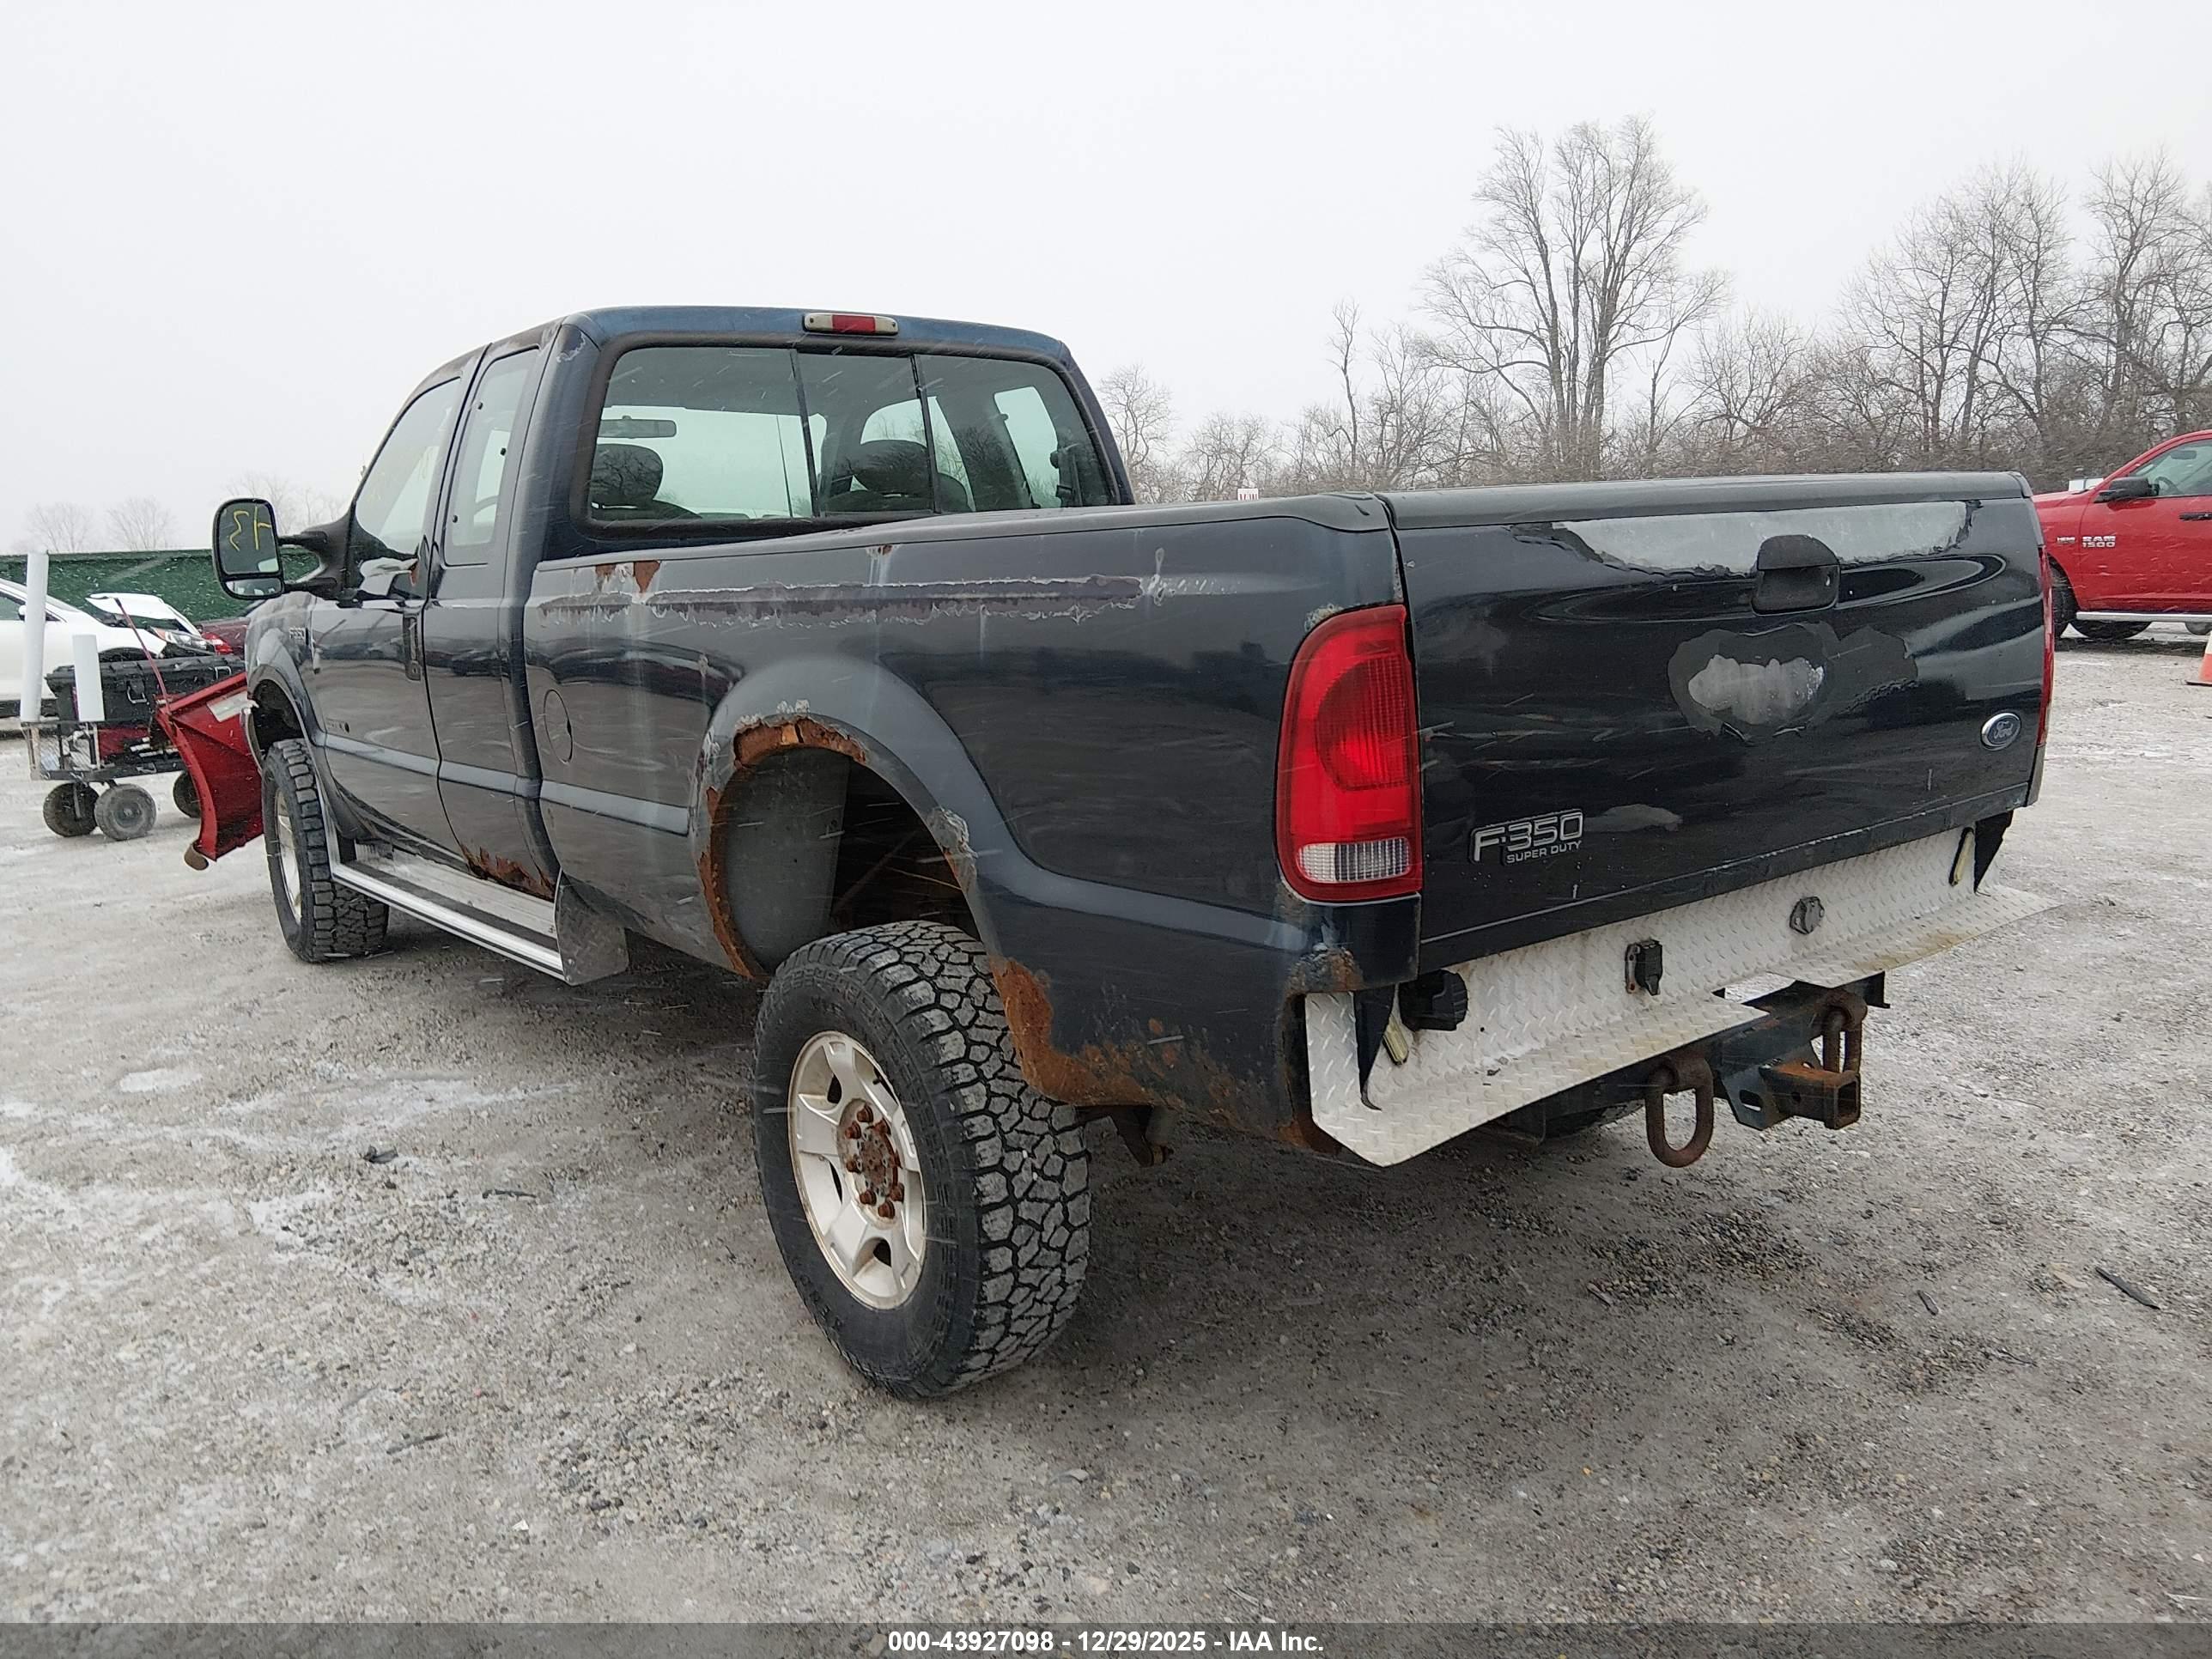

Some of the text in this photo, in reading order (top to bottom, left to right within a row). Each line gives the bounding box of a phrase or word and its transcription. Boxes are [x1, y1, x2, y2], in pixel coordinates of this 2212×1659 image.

[1993, 720, 2014, 739] Ford
[1506, 840, 1582, 864] SUPER DUTY
